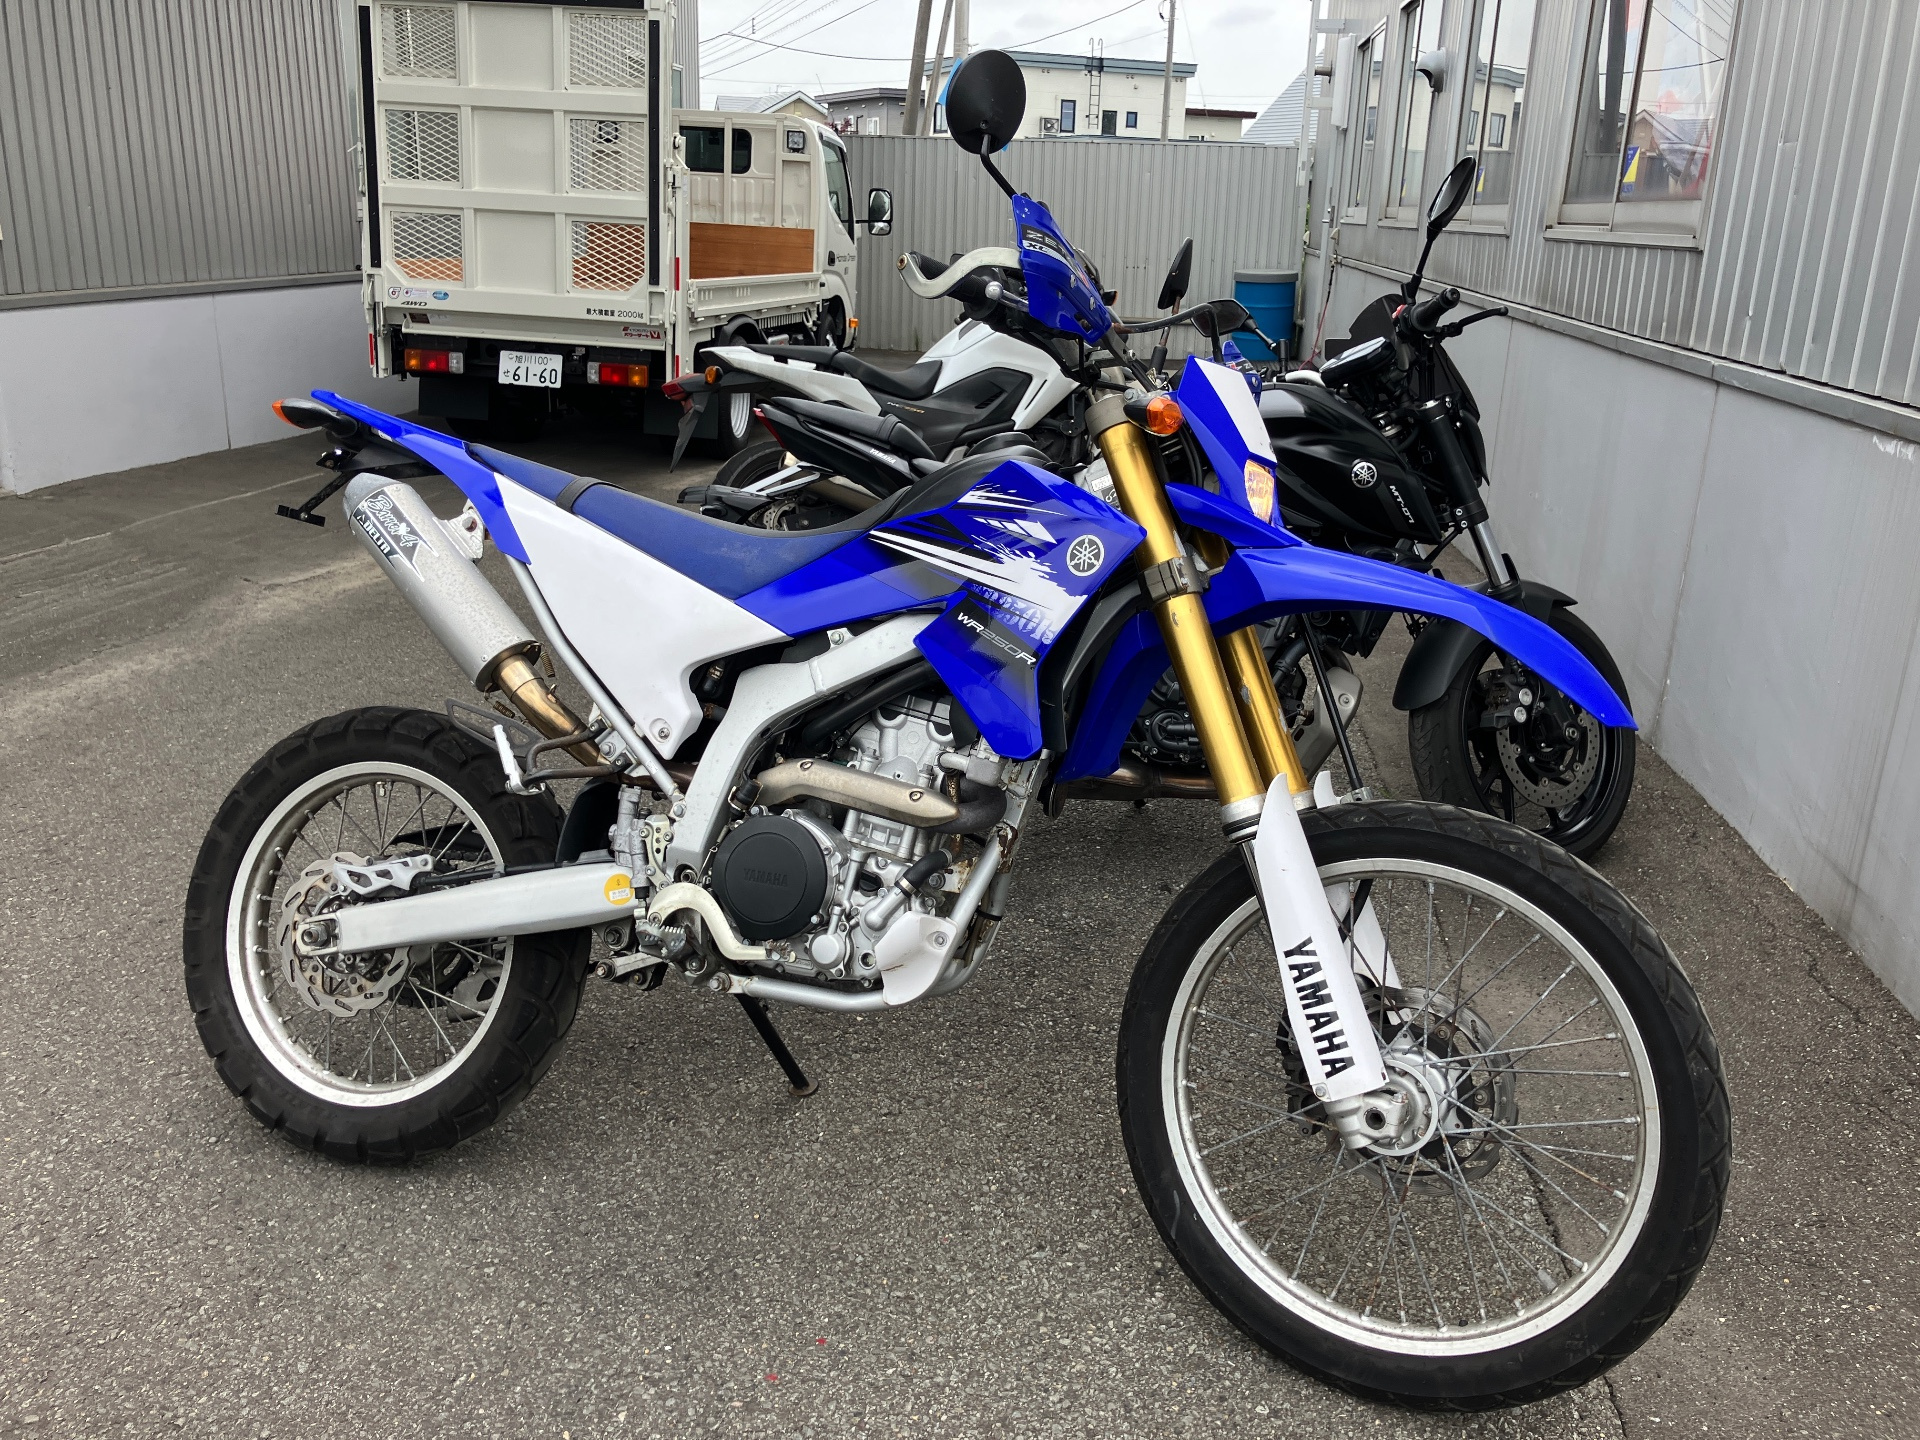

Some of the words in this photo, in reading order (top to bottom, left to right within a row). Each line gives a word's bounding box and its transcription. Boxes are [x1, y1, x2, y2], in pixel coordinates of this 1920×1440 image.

[586, 308, 616, 317] 最大積載量
[512, 366, 558, 384] 61-60
[1390, 485, 1415, 523] MT-07
[957, 612, 1037, 665] WR250R
[743, 868, 788, 887] YAMAHA
[1283, 936, 1355, 1079] YAMAHA
